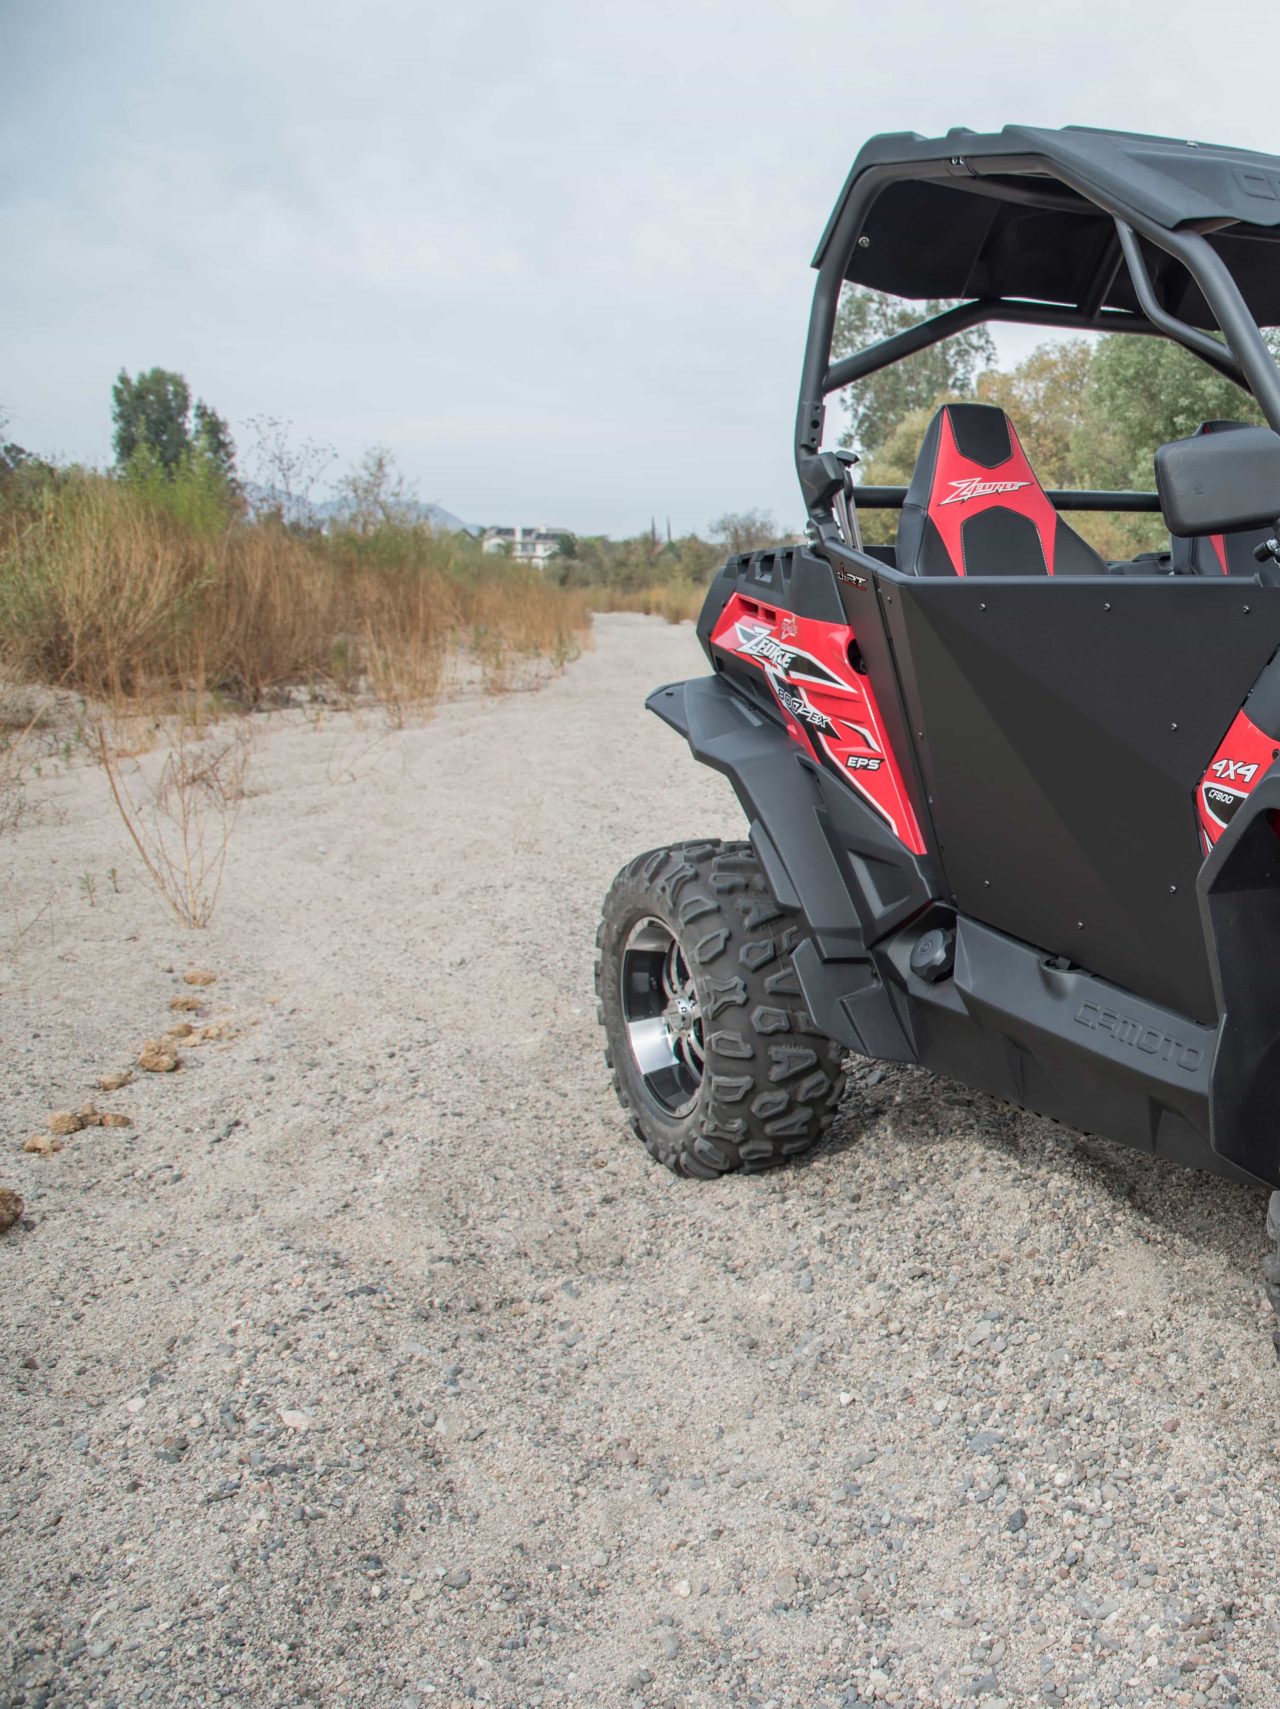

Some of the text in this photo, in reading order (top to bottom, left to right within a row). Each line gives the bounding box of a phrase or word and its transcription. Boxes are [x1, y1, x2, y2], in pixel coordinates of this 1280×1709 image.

[847, 756, 881, 771] EPS
[1211, 759, 1259, 783] 4X4
[1073, 1000, 1205, 1073] CFMOTO
